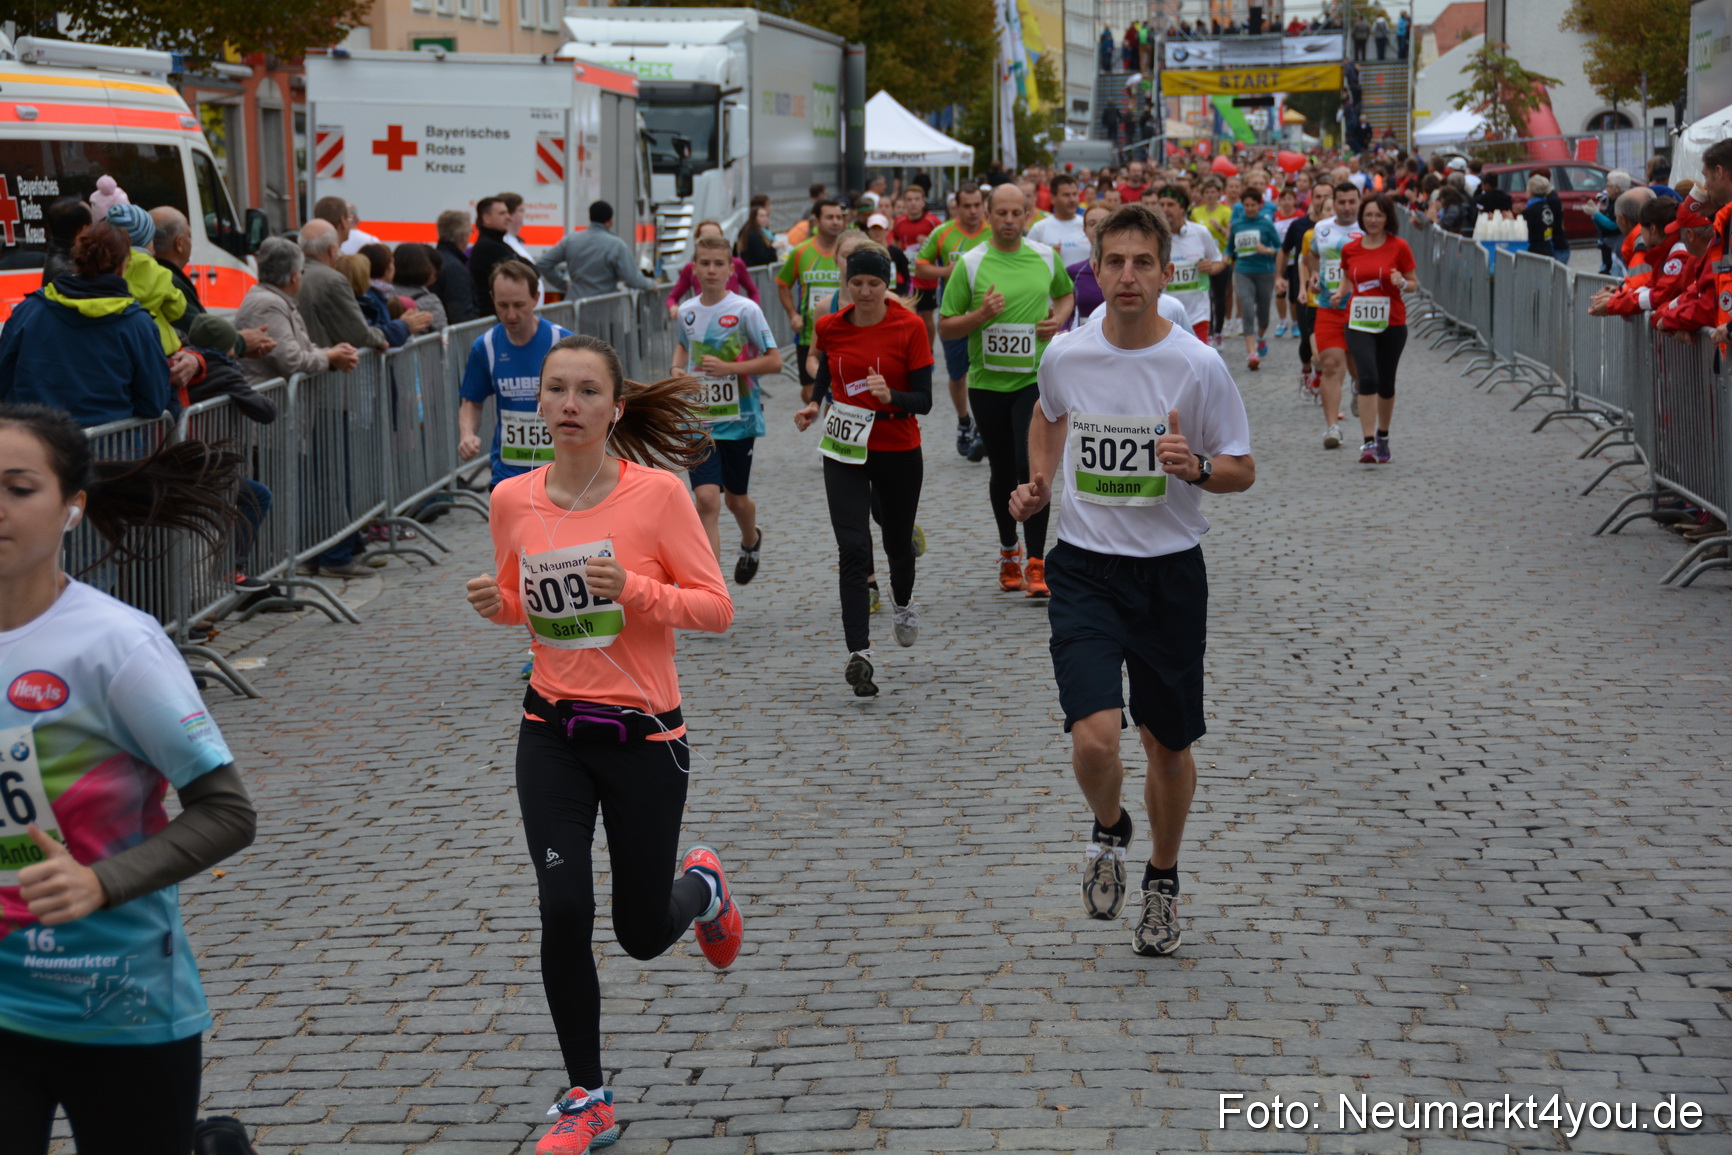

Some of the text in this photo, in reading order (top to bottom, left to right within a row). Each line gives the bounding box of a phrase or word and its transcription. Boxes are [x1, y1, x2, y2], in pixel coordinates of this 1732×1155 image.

[1219, 72, 1281, 89] START
[425, 125, 510, 141] Bayerisches
[425, 143, 466, 156] Rotes
[870, 152, 926, 162] Laufsport
[425, 161, 466, 173] Kreuz
[17, 175, 60, 200] Bayerisches
[21, 199, 43, 219] Rotes
[24, 222, 47, 243] Kreuz
[804, 271, 841, 283] BOC
[1328, 268, 1342, 280] 51
[1354, 305, 1385, 319] 5101
[987, 335, 1031, 354] 5320
[497, 376, 541, 391] HUBE
[507, 424, 553, 446] 5155
[827, 415, 866, 442] 5067
[1073, 421, 1151, 435] PARTL Neumarkt
[1081, 436, 1156, 472] 5021
[1096, 479, 1141, 494] Johann
[551, 619, 594, 637] Sarah
[14, 679, 62, 704] Hervis
[0, 770, 37, 828] 6
[24, 928, 65, 953] 16.
[24, 954, 119, 969] Neumarkter
